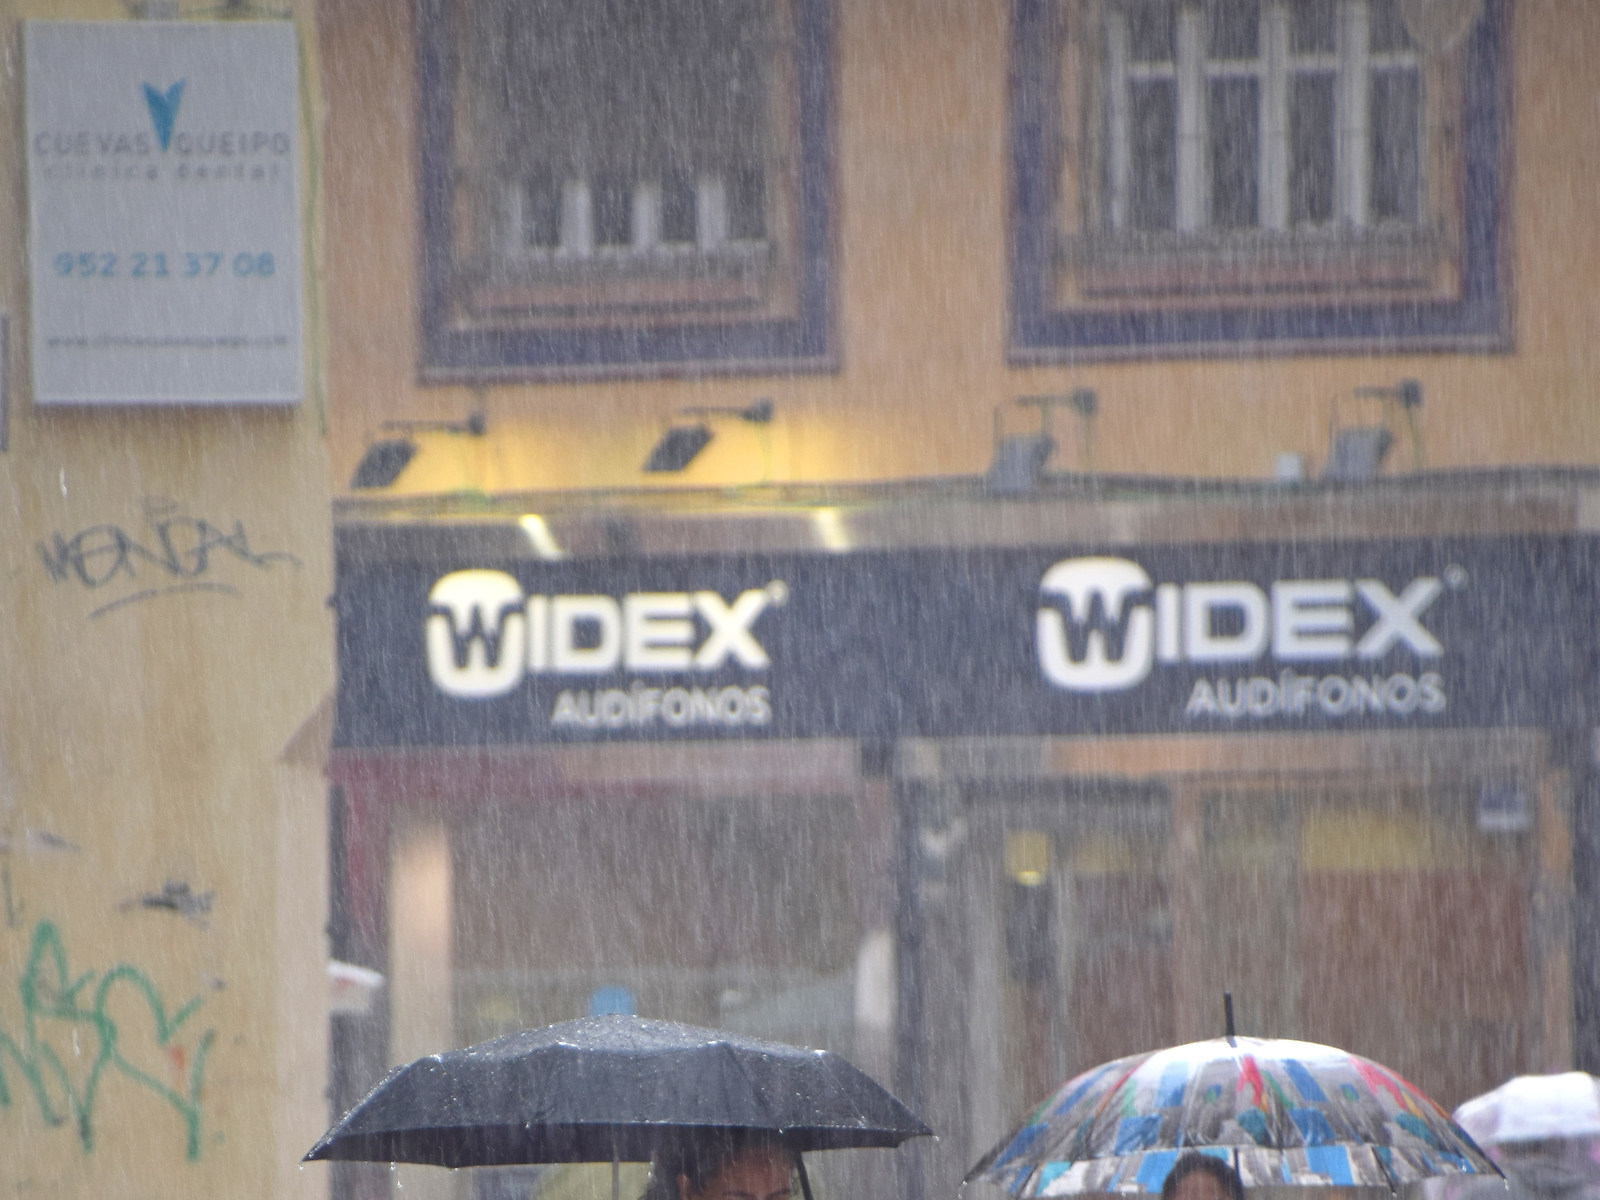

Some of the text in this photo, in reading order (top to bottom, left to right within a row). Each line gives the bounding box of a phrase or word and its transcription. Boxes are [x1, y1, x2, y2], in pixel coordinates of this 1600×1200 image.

[34, 131, 290, 156] CUEVAS QUEIPO
[53, 251, 276, 278] 952 21 37 08
[427, 568, 771, 697] WIDEX
[1037, 556, 1446, 692] WIDEX
